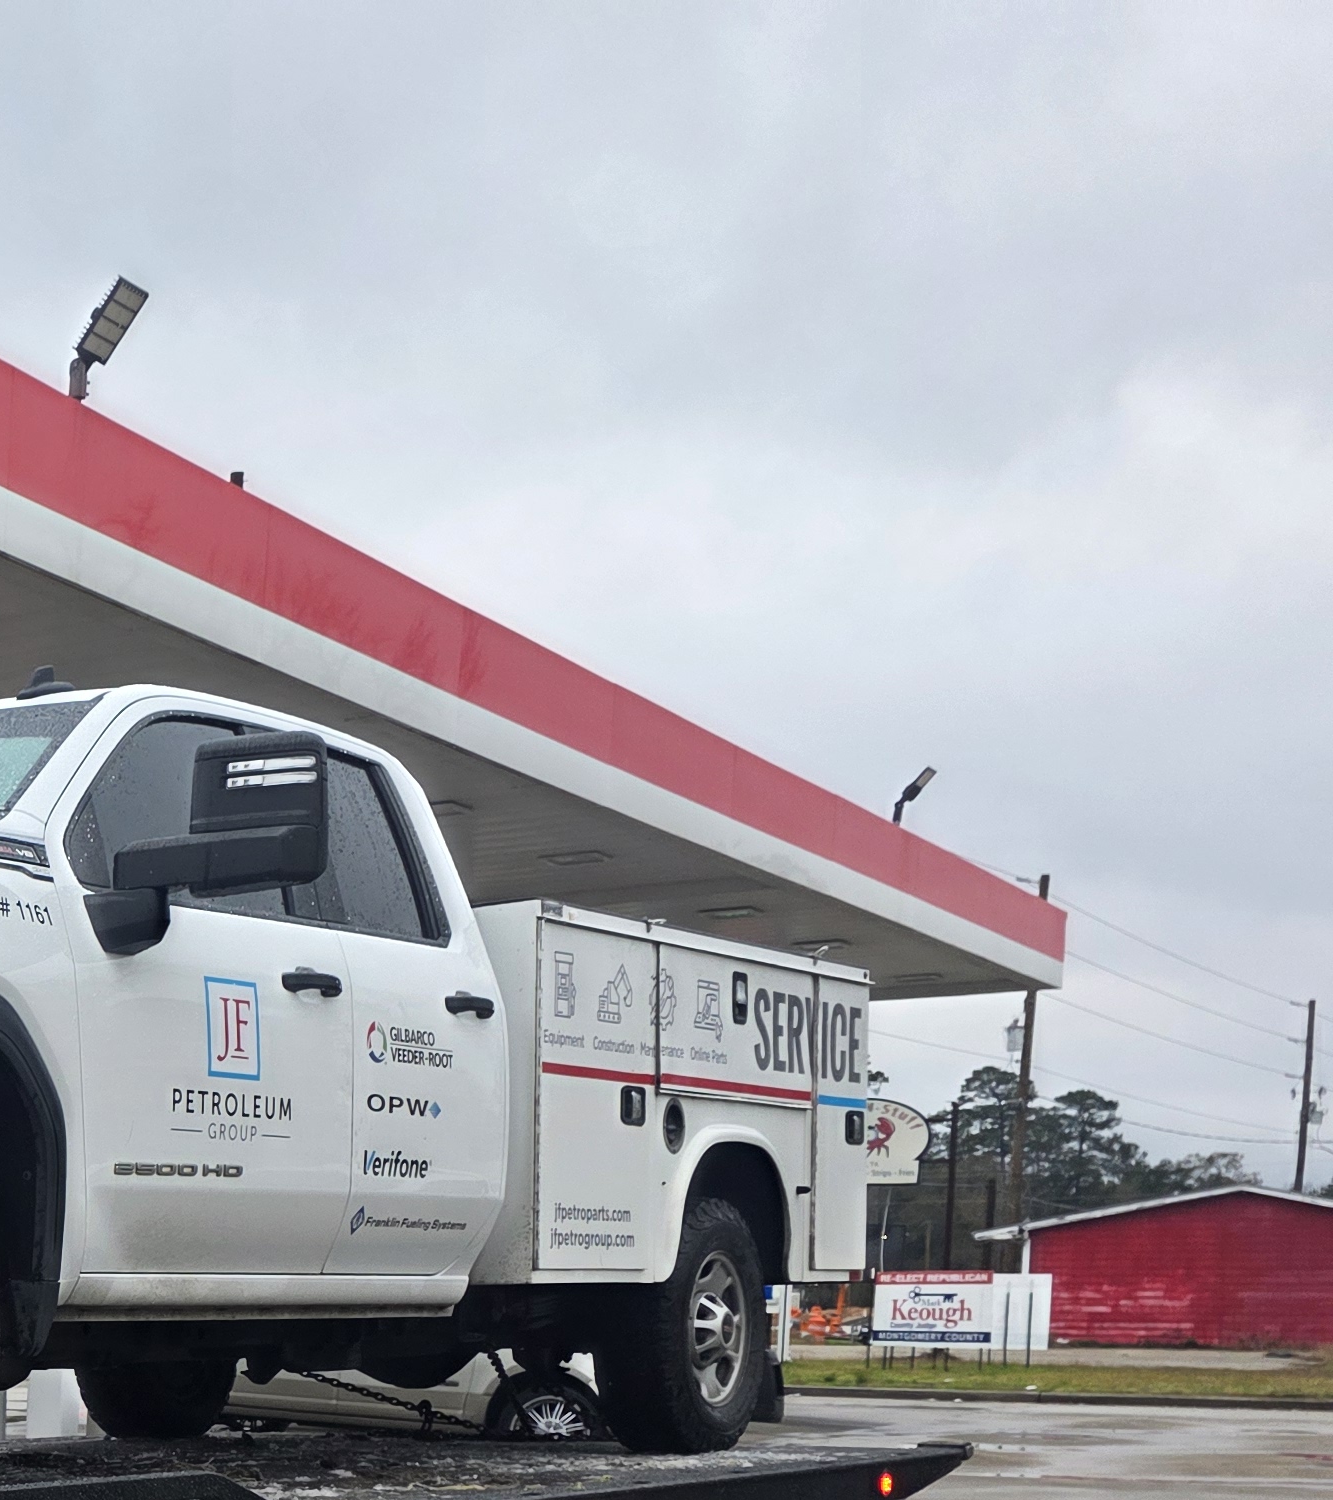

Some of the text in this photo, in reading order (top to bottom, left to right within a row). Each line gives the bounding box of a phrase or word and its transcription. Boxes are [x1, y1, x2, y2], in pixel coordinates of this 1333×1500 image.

[0, 896, 11, 918] #
[16, 900, 53, 926] 1161
[216, 997, 251, 1062] JF
[389, 1026, 435, 1047] GILBARCO
[753, 987, 862, 1084] SERVICE
[543, 1029, 585, 1048] Equipment
[592, 1035, 635, 1055] Construction
[690, 1046, 711, 1063] Online
[711, 1051, 728, 1065] Parts
[390, 1049, 453, 1069] VEEDER-ROOT
[172, 1088, 292, 1121] PETROLEUM
[366, 1093, 429, 1117] OPW
[207, 1122, 258, 1142] GROUP
[113, 1162, 243, 1177] 2500 HD
[363, 1150, 429, 1178] Verifone
[364, 1216, 467, 1231] Franklin Fueling Systems
[554, 1202, 631, 1224] jfpetroparts.com
[550, 1228, 635, 1250] jfpetrogroup.com
[880, 1271, 988, 1283] RE-ELECT REPUBLICAN
[891, 1298, 972, 1329] Keough
[878, 1332, 985, 1342] MONTGOMERY COUNTY
